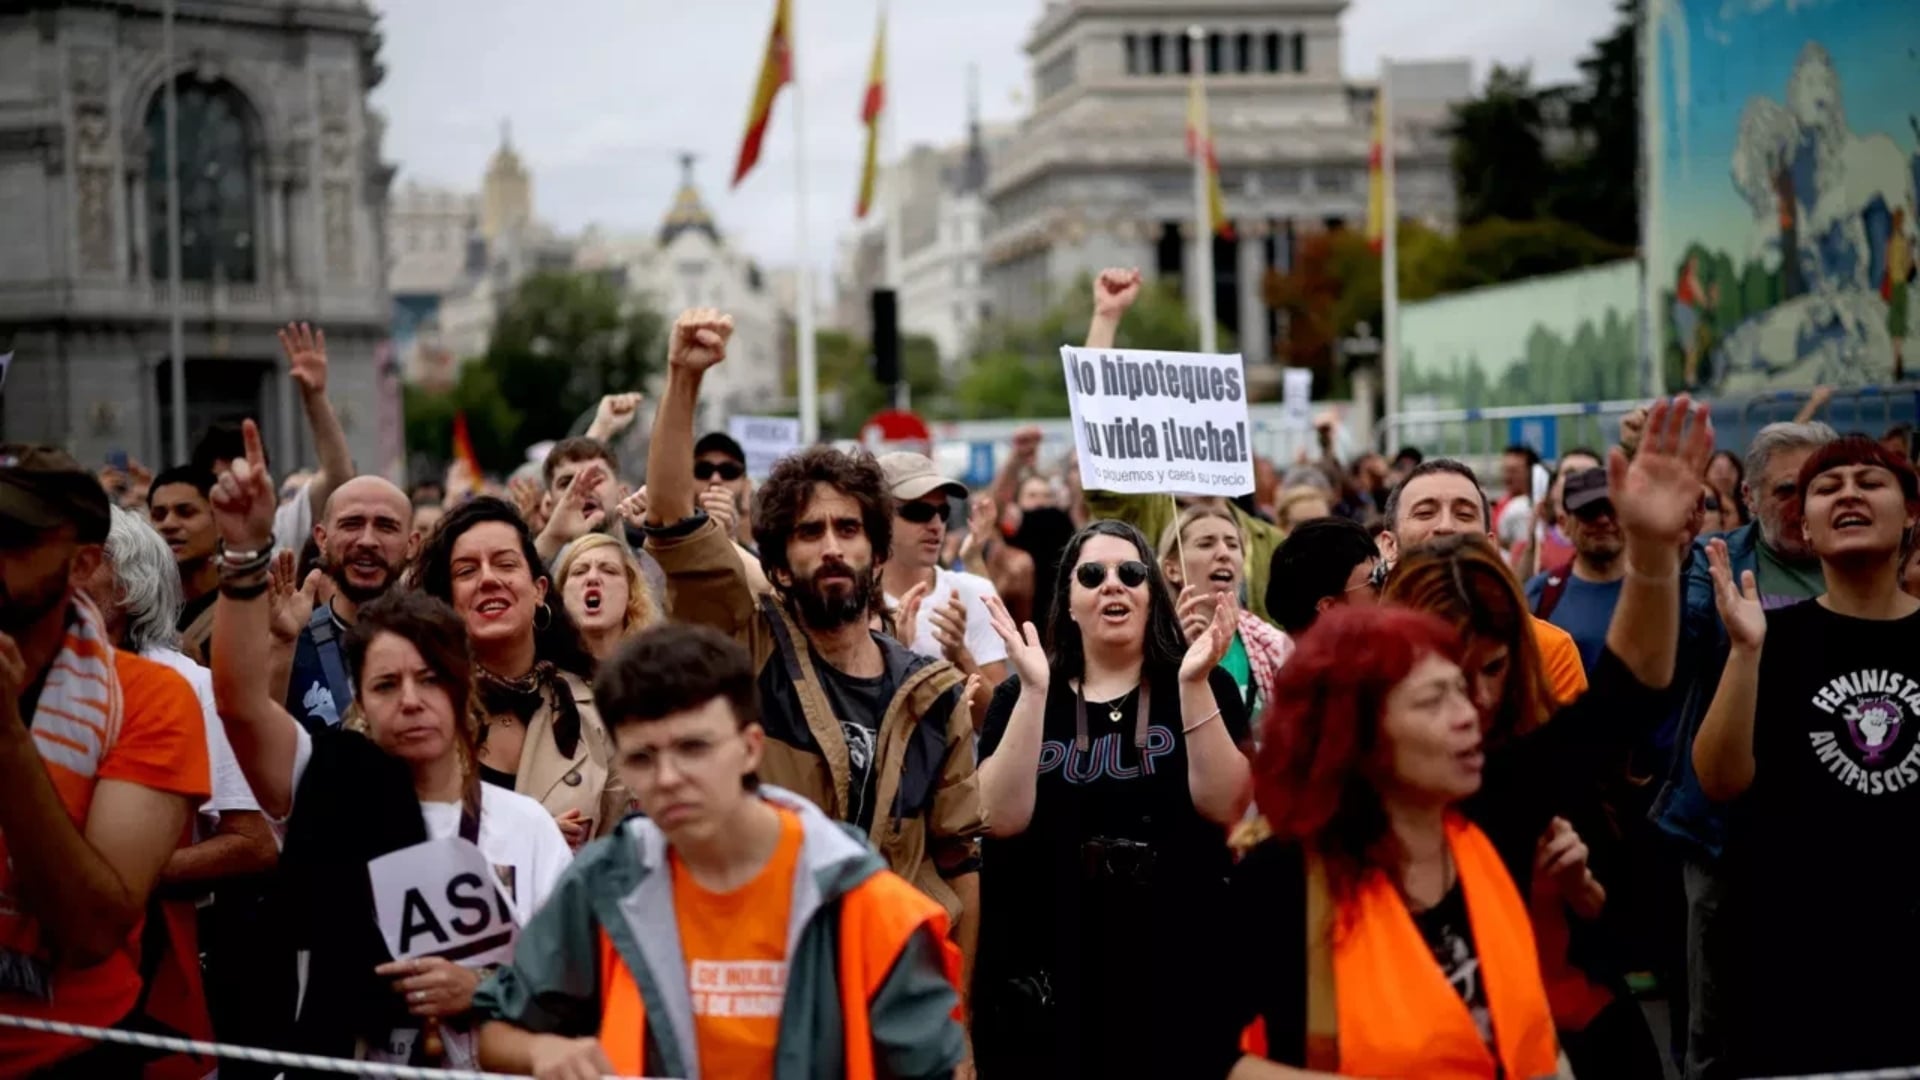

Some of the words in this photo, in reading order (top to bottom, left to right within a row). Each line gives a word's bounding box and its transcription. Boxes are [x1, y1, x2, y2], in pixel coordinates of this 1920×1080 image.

[1100, 355, 1242, 404] hipoteques
[1102, 417, 1160, 459] vida
[1162, 418, 1248, 463] ¡Lucha!
[1156, 469, 1165, 484] y
[1037, 725, 1175, 784] PULP
